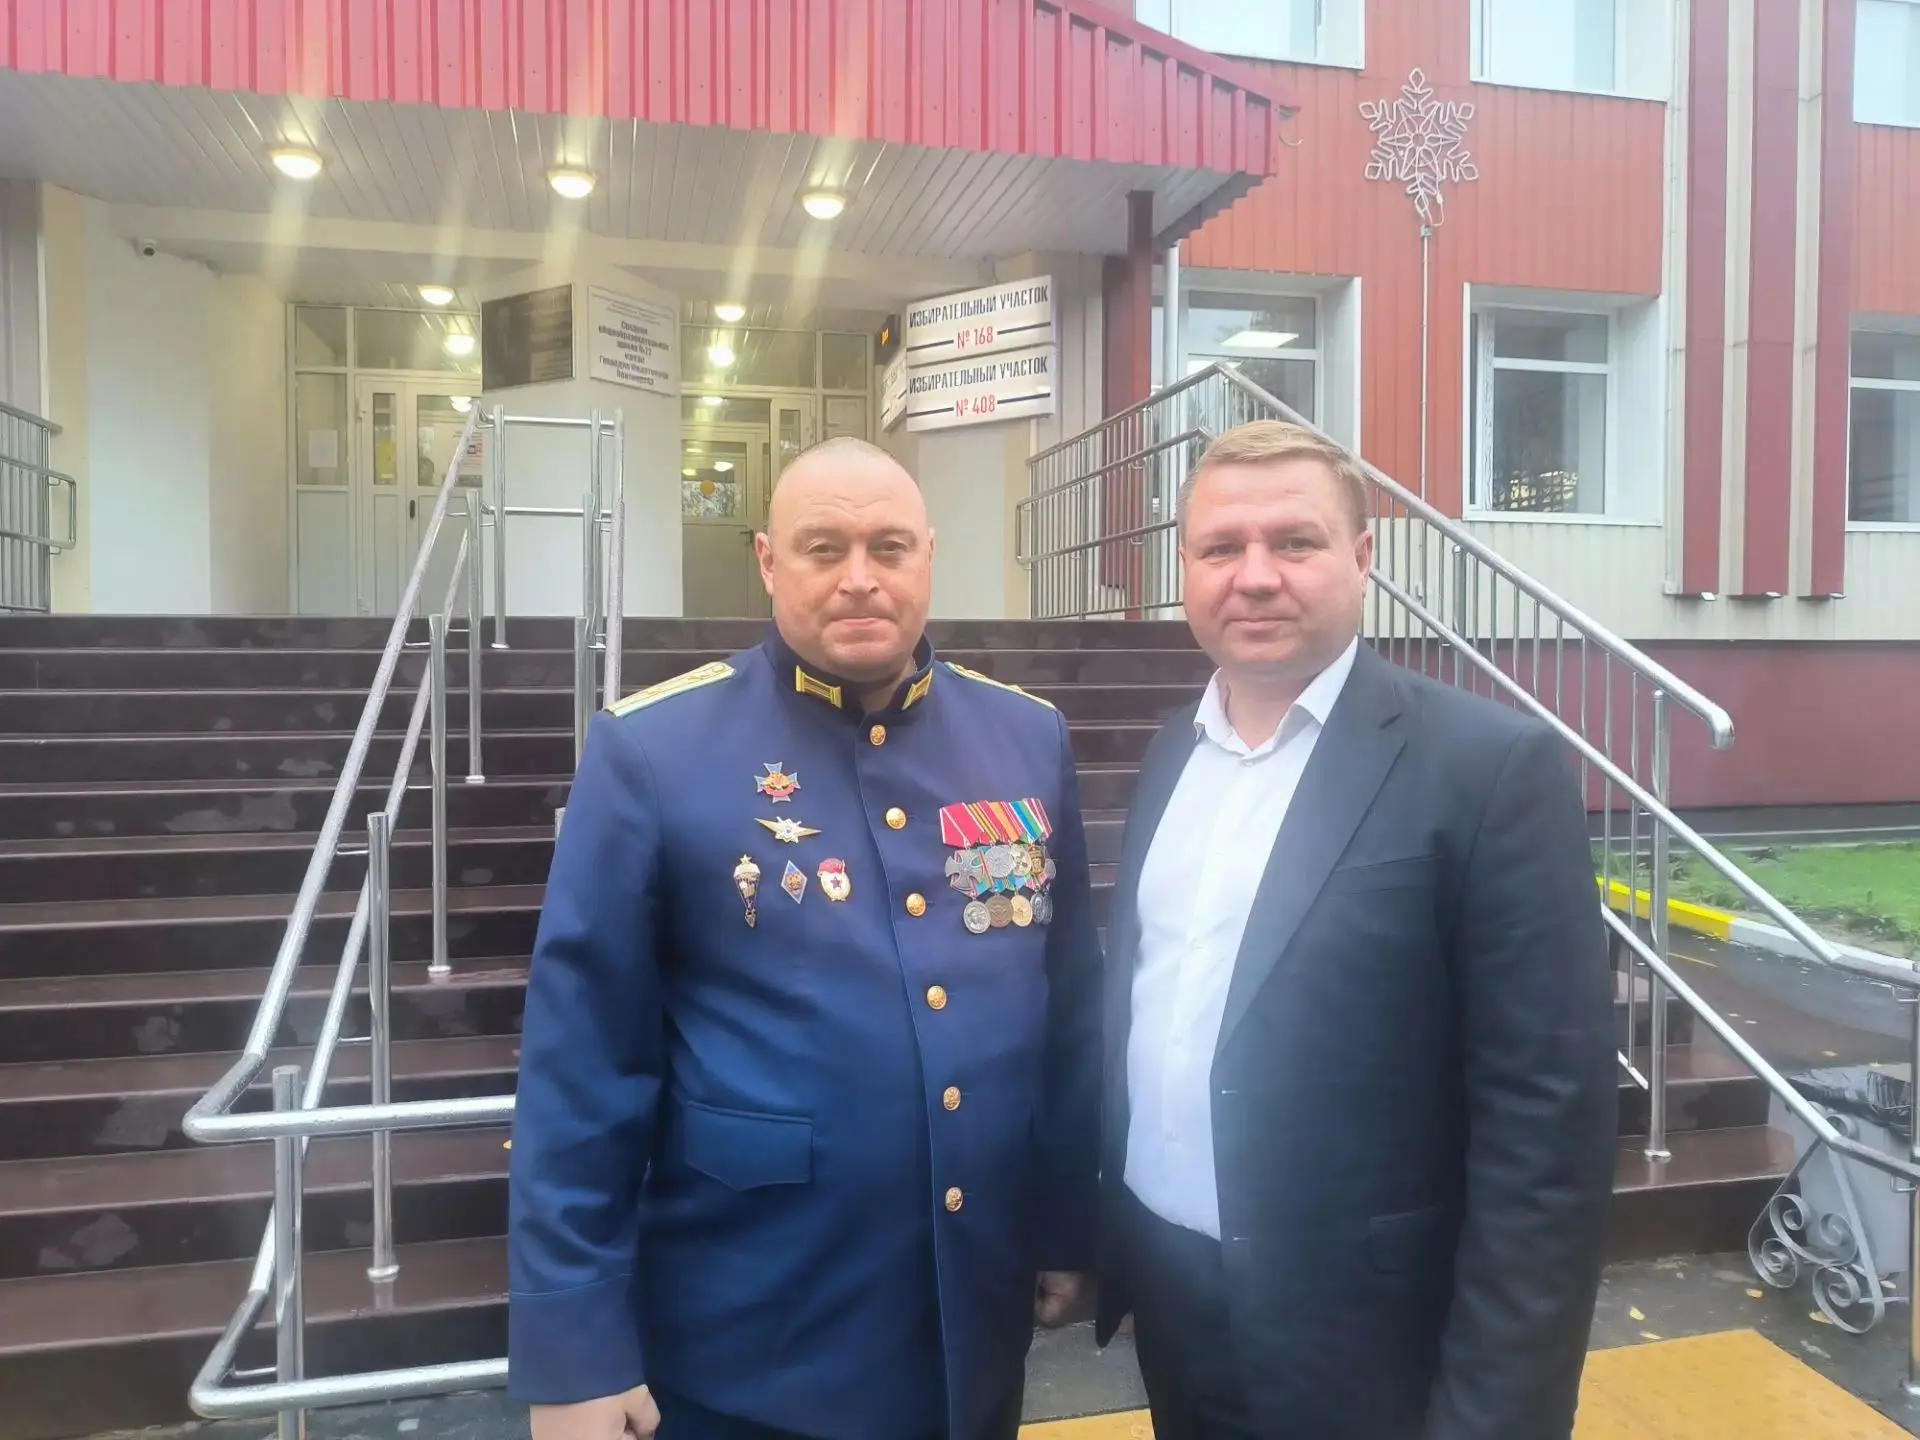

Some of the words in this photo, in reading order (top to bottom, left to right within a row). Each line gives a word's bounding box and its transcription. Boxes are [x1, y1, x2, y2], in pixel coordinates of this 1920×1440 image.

[1000, 285, 1049, 310] УЧАСТОК
[957, 329, 970, 349] №
[974, 326, 994, 345] 168
[1000, 356, 1048, 379] УЧАСТОК
[956, 398, 969, 417] №
[972, 394, 996, 414] 408
